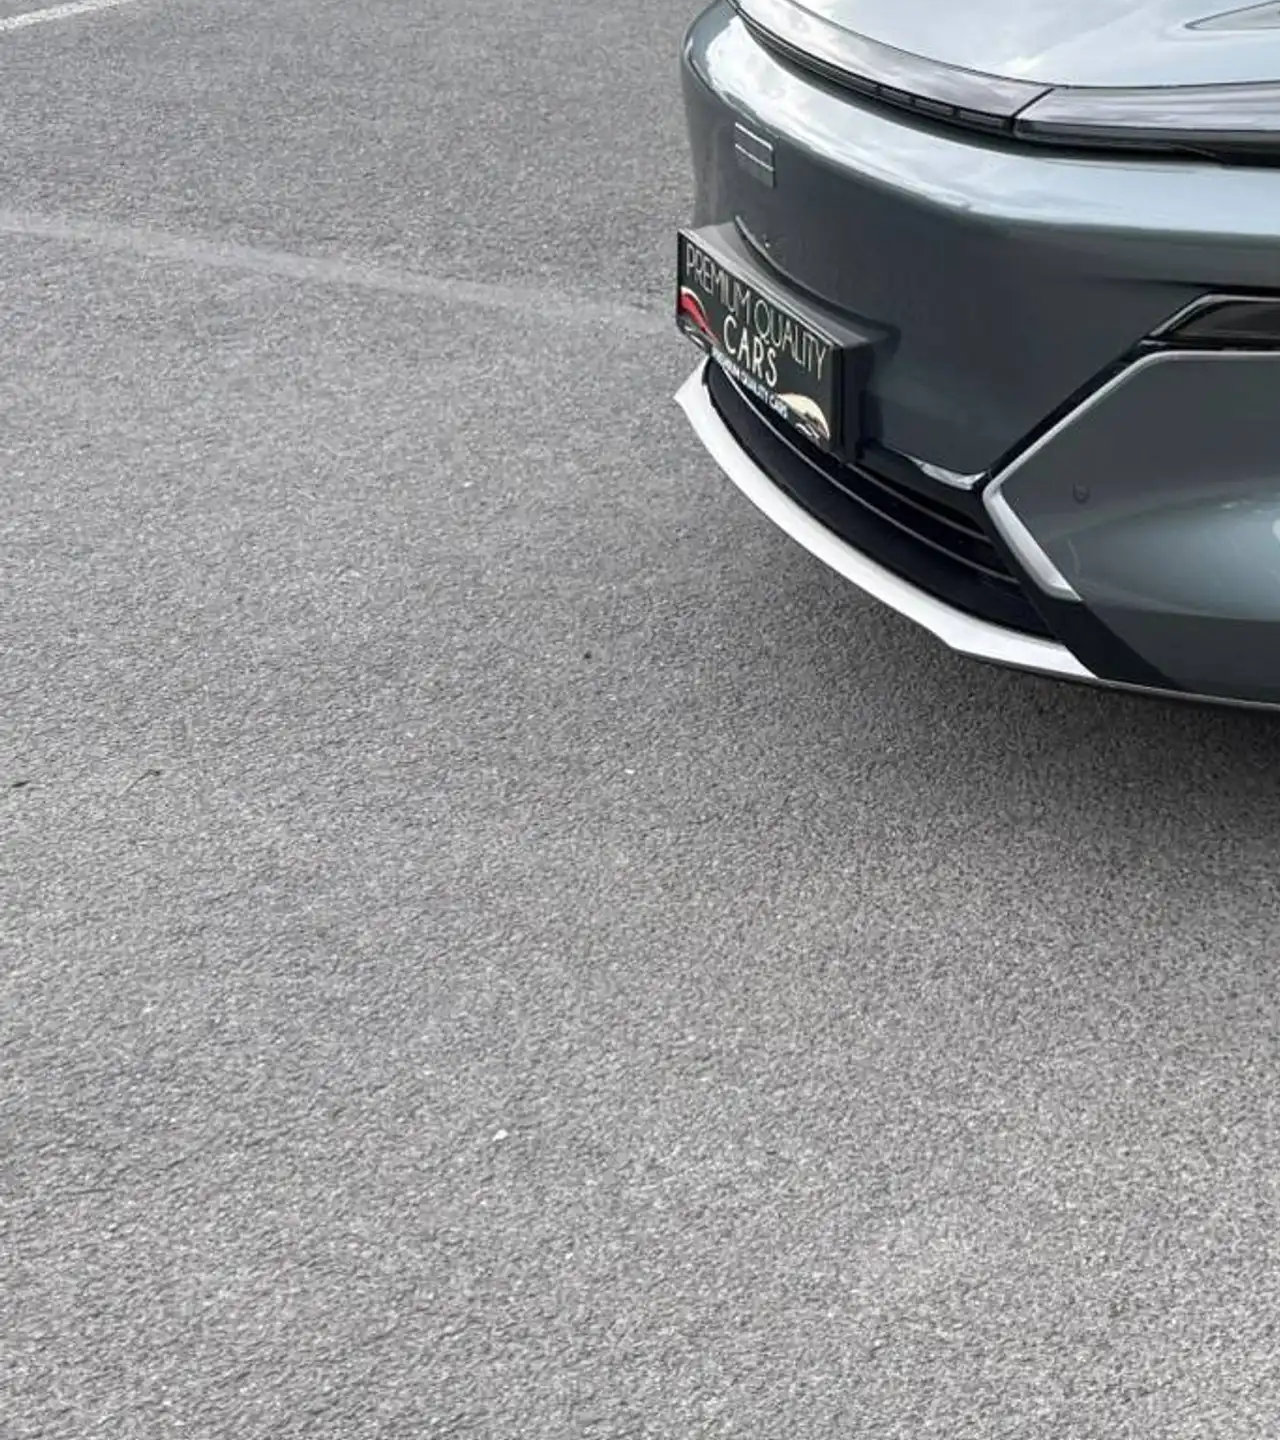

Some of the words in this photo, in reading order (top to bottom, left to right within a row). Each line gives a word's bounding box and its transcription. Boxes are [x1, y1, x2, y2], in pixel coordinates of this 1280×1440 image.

[685, 241, 752, 328] PREMIUM
[753, 298, 828, 382] QUALITY
[723, 314, 778, 388] CARS
